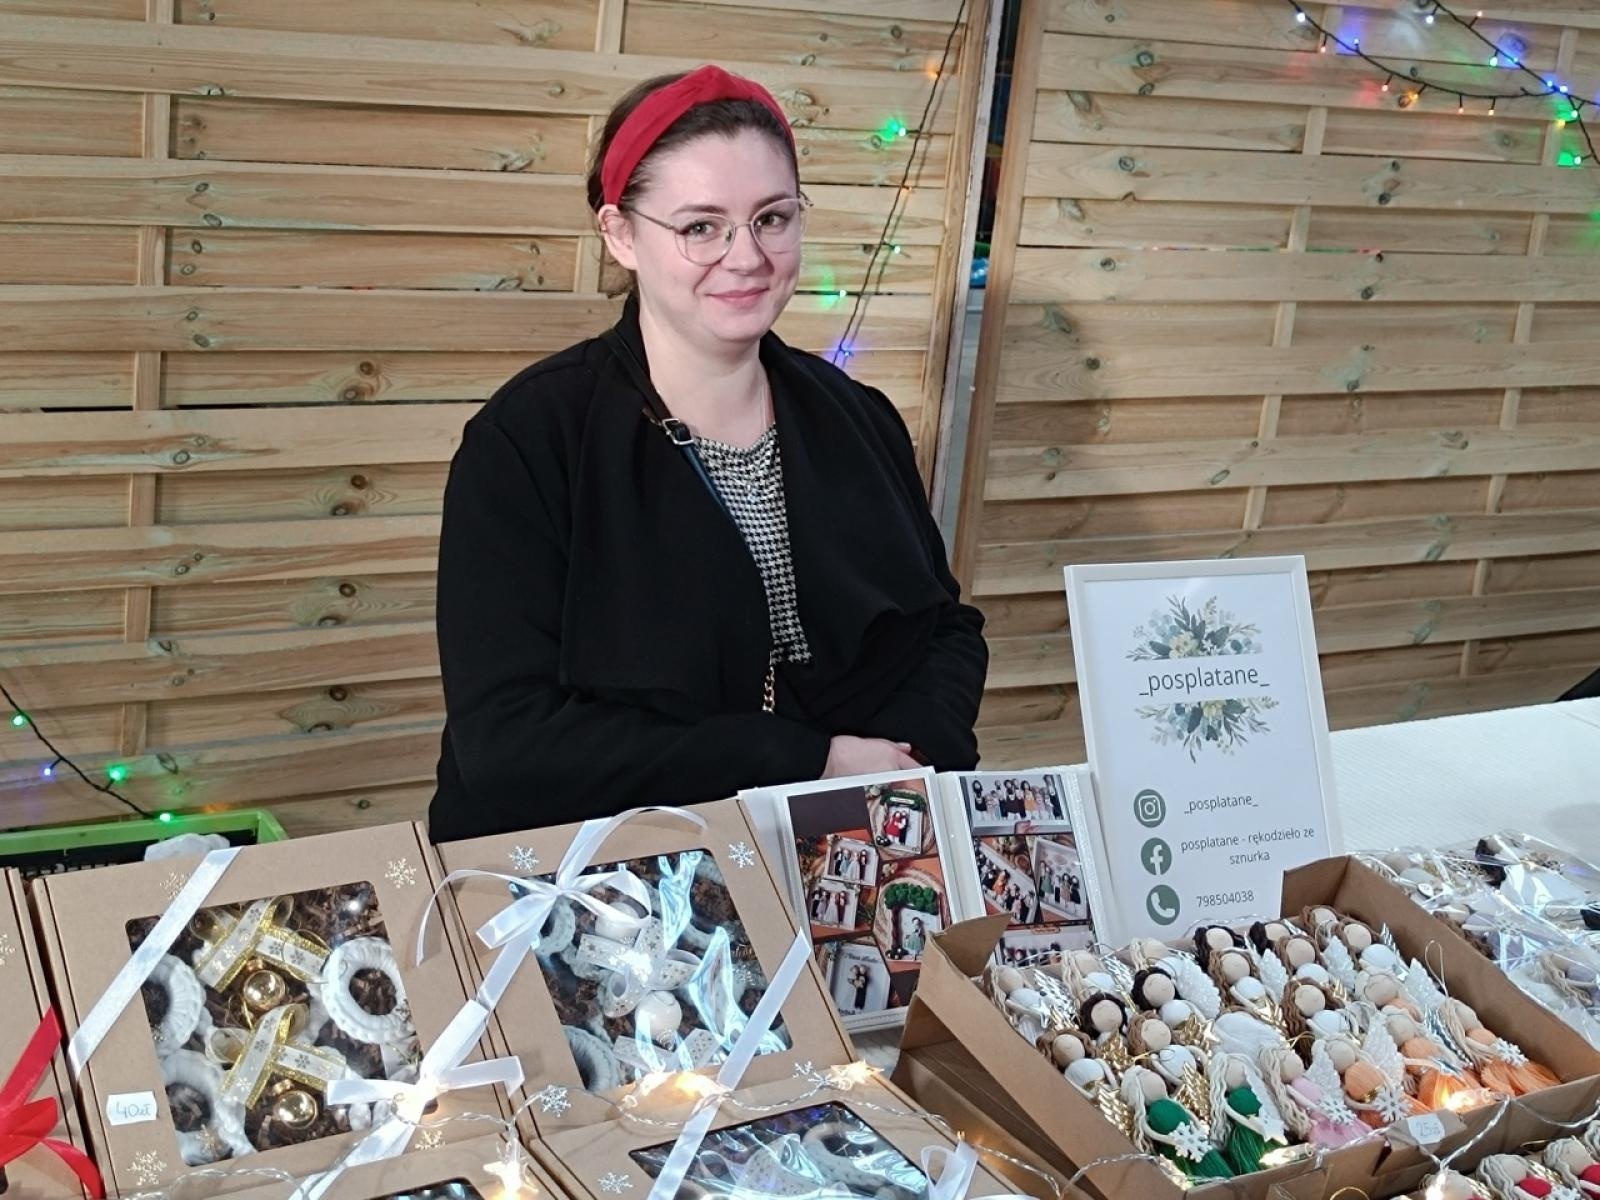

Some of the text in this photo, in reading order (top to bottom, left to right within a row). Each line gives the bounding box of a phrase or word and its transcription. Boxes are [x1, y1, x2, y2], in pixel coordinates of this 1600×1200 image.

[1139, 666, 1270, 696] _posplatane_
[1184, 795, 1259, 814] _posplatane_
[1180, 835, 1239, 853] posplatane
[1249, 828, 1301, 845] rękodzieło
[1303, 827, 1315, 838] ze
[1229, 851, 1270, 865] sznurka
[1196, 890, 1254, 908] 798504038
